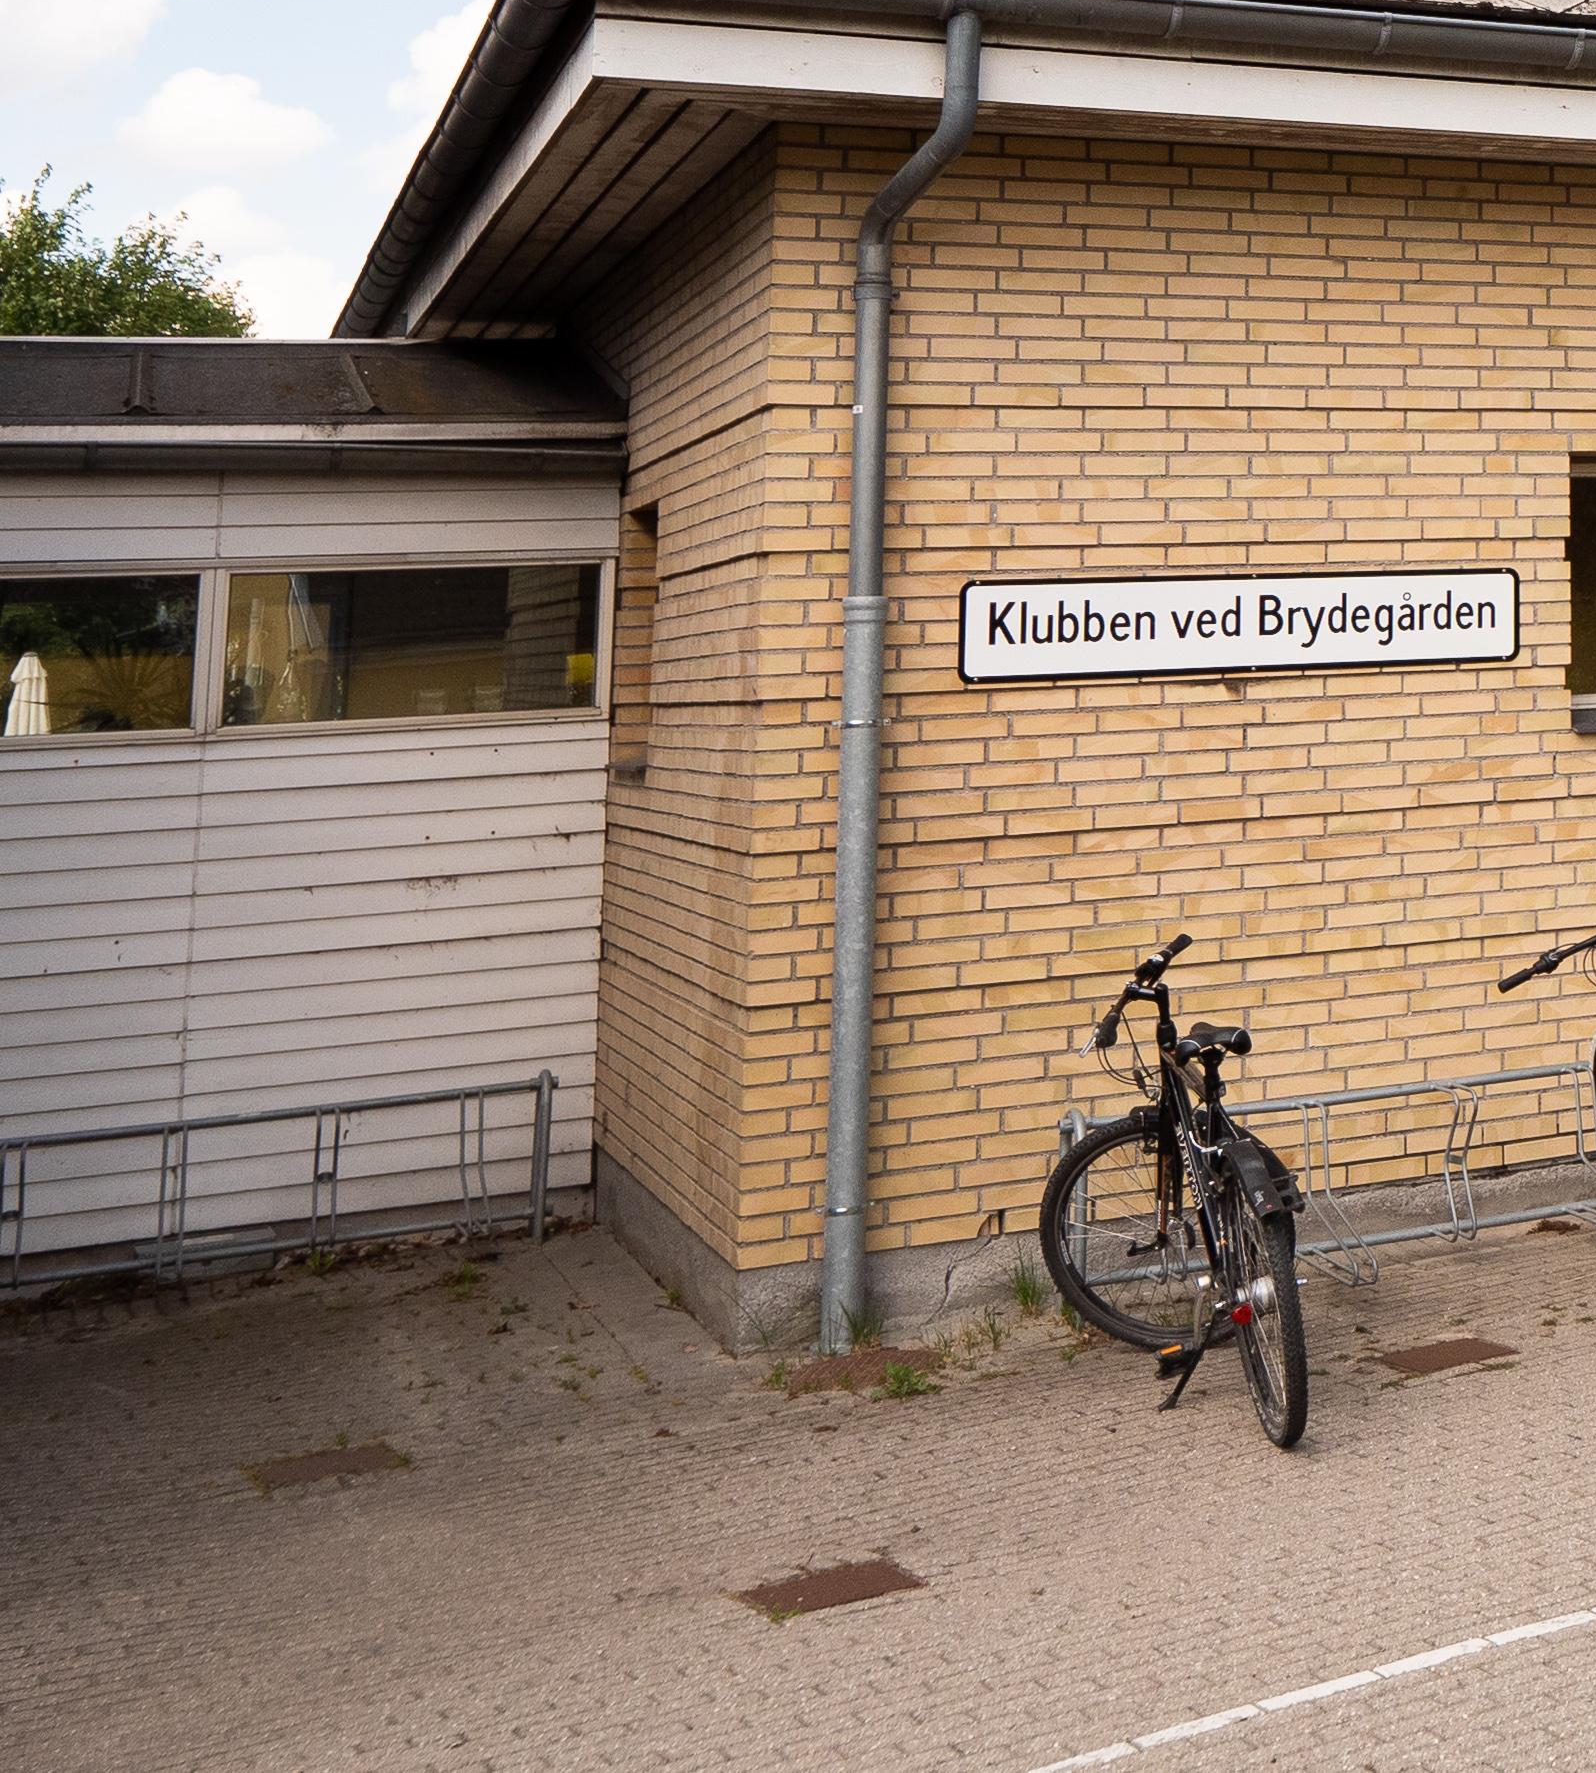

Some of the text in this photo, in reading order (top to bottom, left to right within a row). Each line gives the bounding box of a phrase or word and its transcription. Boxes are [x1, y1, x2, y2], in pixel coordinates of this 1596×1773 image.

[987, 590, 1496, 649] Klubben ved Brydegården
